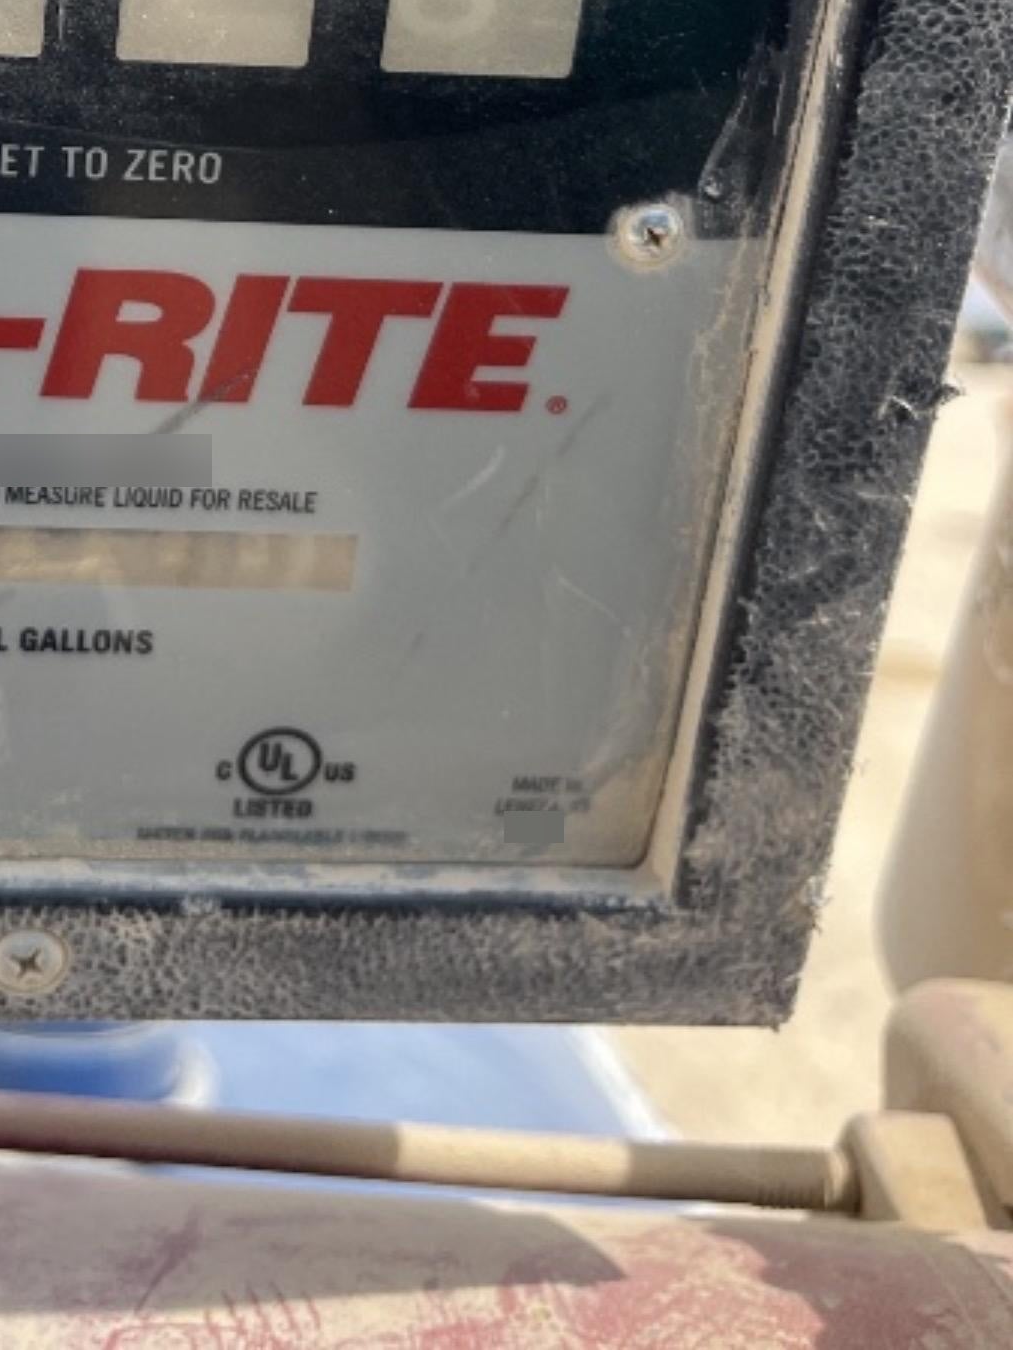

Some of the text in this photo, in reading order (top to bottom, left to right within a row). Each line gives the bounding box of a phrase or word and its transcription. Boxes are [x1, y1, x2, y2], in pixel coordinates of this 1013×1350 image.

[60, 146, 109, 179] TO
[122, 148, 223, 184] ZERO
[4, 486, 108, 508] MEASURE
[113, 486, 183, 509] LIQUID
[190, 488, 231, 511] FOR
[238, 488, 319, 514] RESALE
[19, 626, 154, 655] GALLONS
[258, 741, 300, 782] UL
[323, 761, 356, 783] US
[233, 798, 313, 820] LISTED
